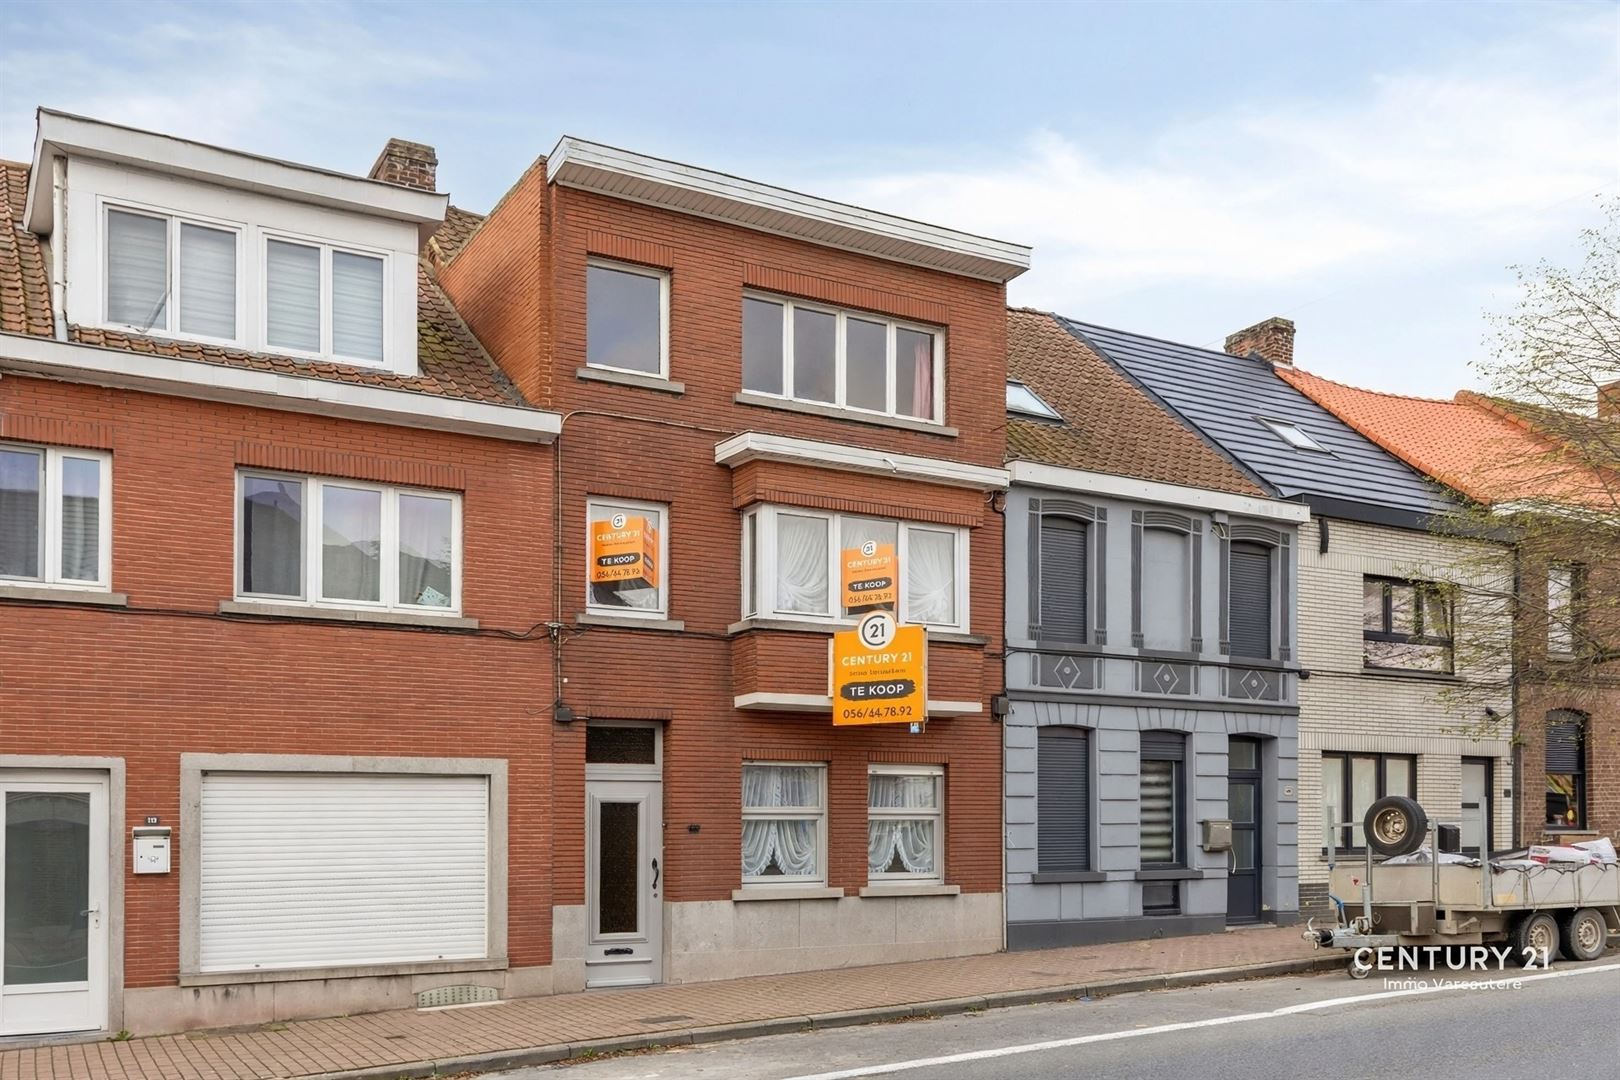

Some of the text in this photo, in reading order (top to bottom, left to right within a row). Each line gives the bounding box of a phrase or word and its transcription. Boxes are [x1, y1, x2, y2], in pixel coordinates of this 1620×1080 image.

[613, 555, 635, 565] KOOP
[864, 580, 886, 589] KOOP
[841, 652, 912, 666] CENTURY 21
[850, 684, 905, 696] TE KOOP
[843, 706, 912, 719] 056/44.78.92
